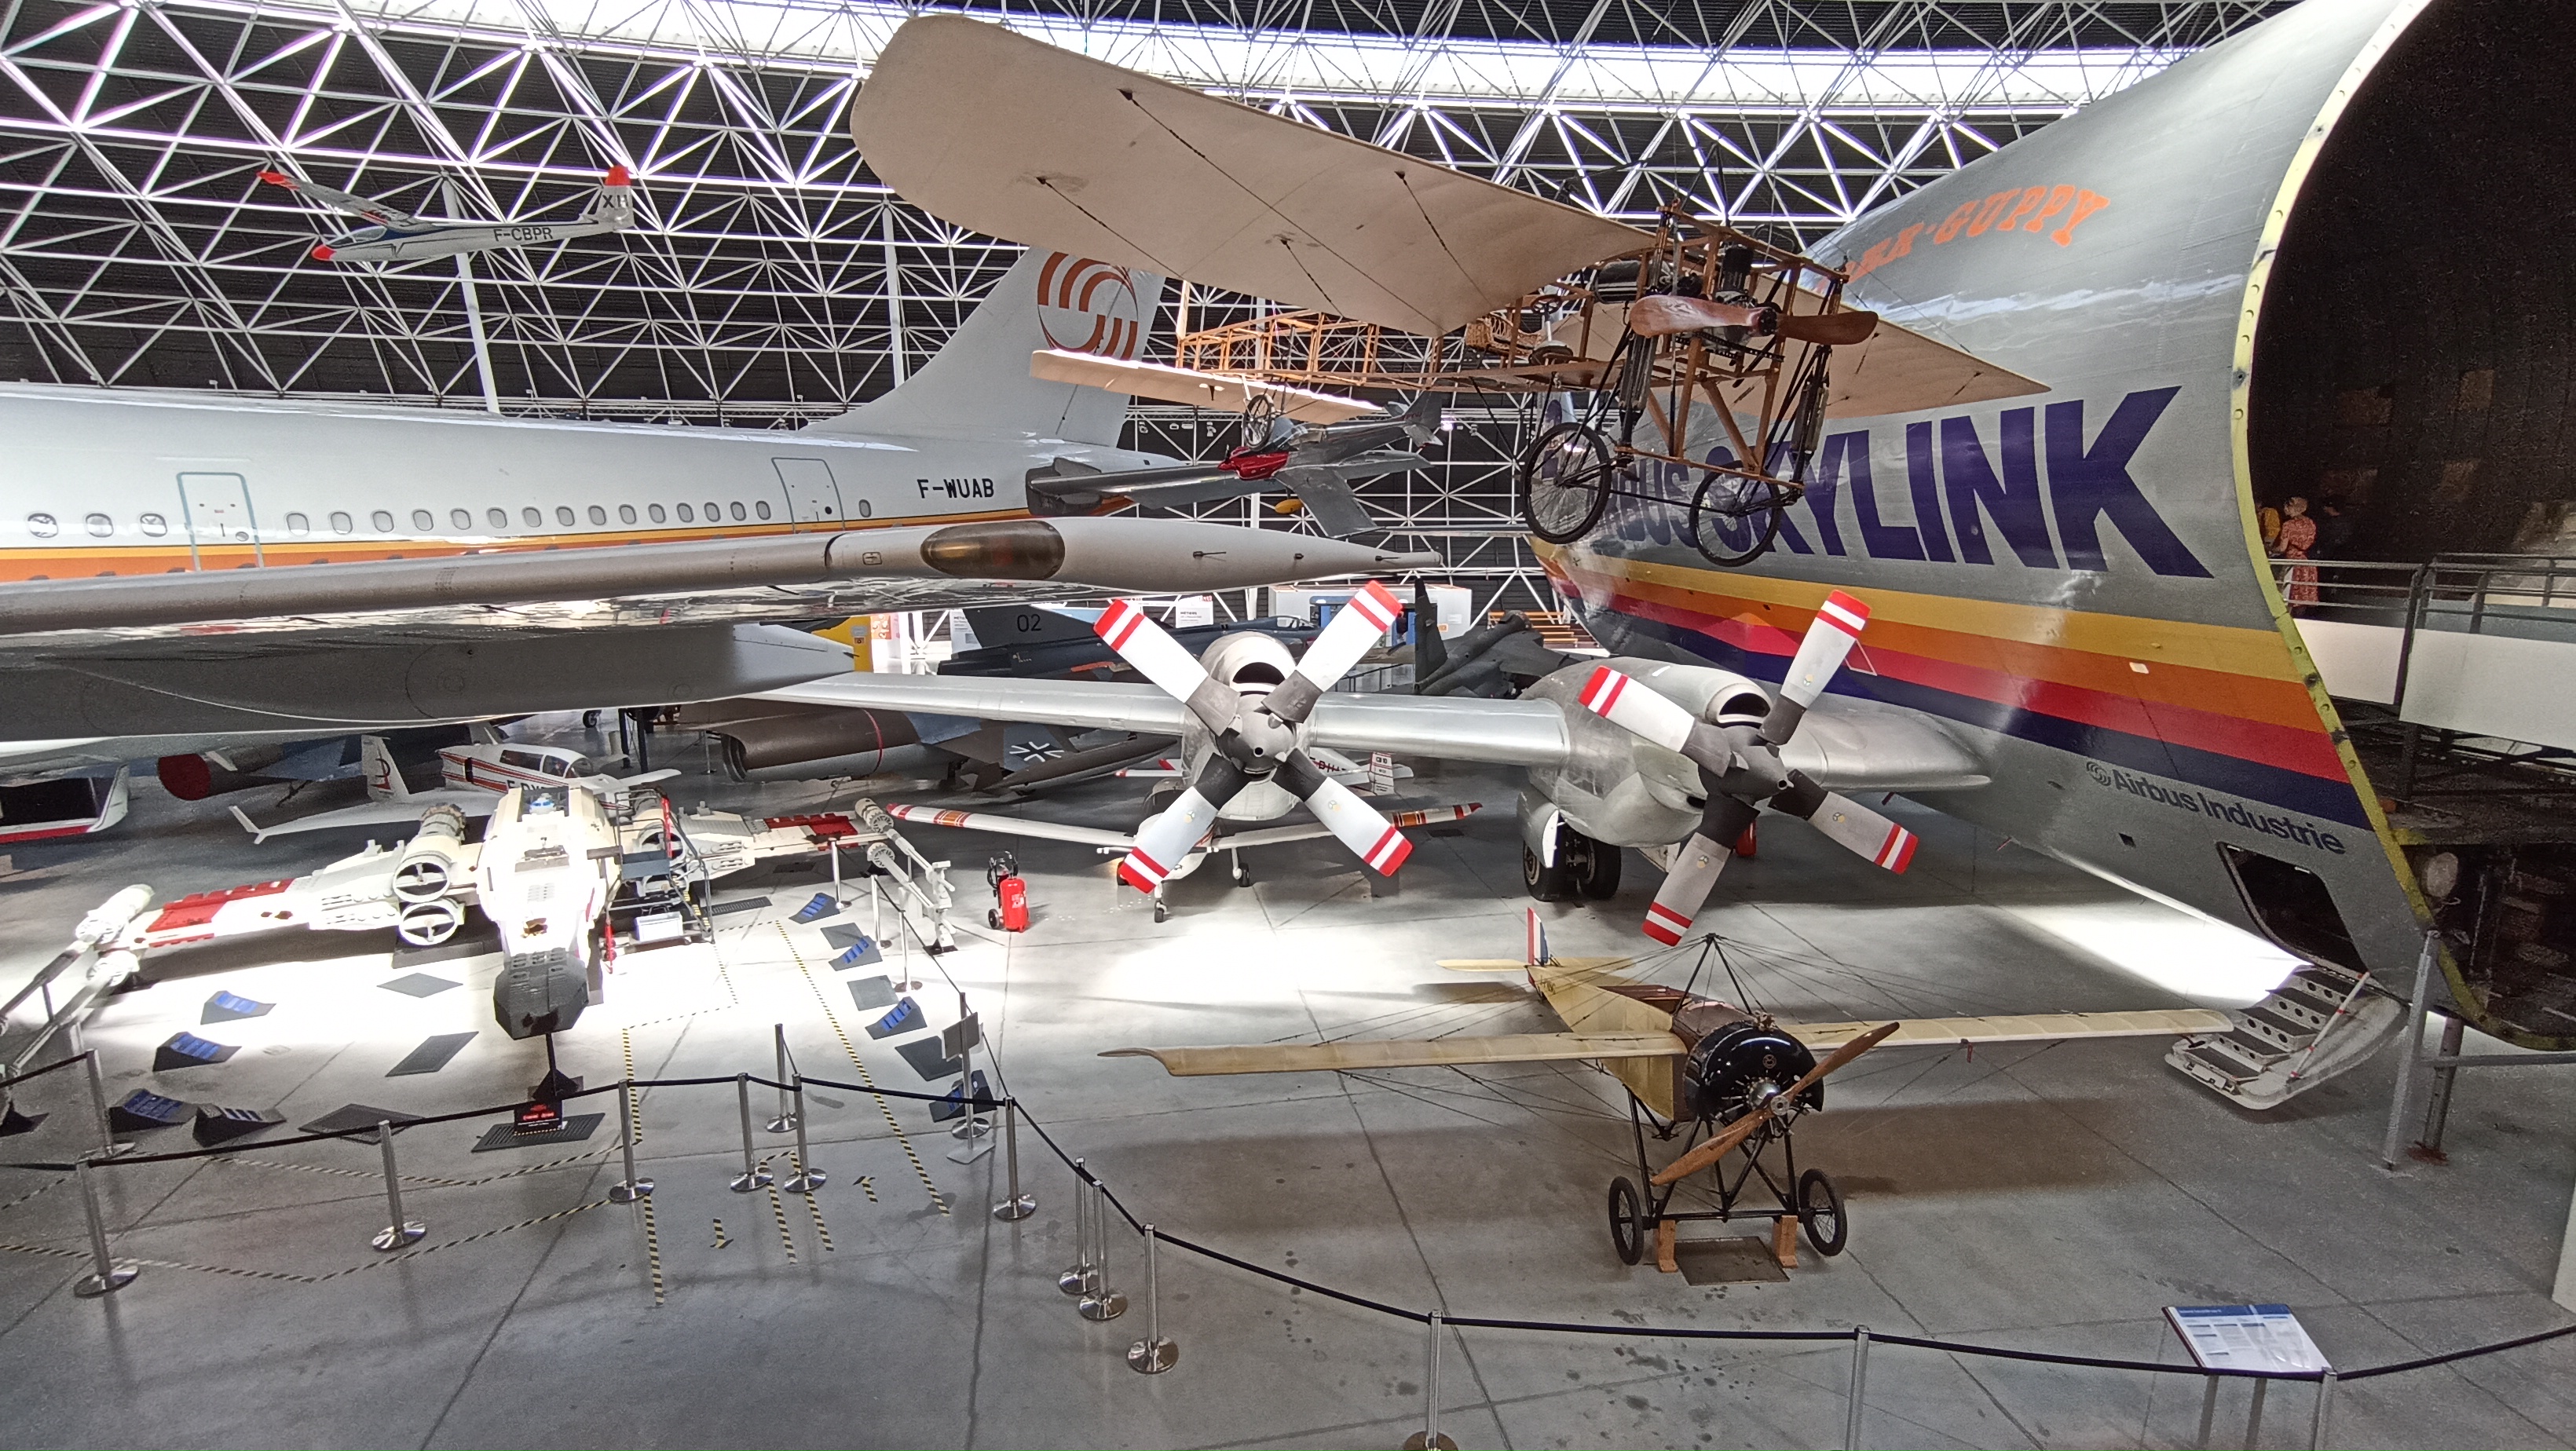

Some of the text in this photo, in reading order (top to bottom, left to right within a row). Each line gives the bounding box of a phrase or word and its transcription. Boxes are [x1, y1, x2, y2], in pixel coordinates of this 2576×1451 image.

[492, 227, 554, 242] F-CBPR
[917, 478, 994, 499] F-WUAB
[1706, 386, 2215, 579] SKYLINK
[1016, 613, 1042, 633] 02
[2112, 769, 2347, 855] Airbus Industrie
